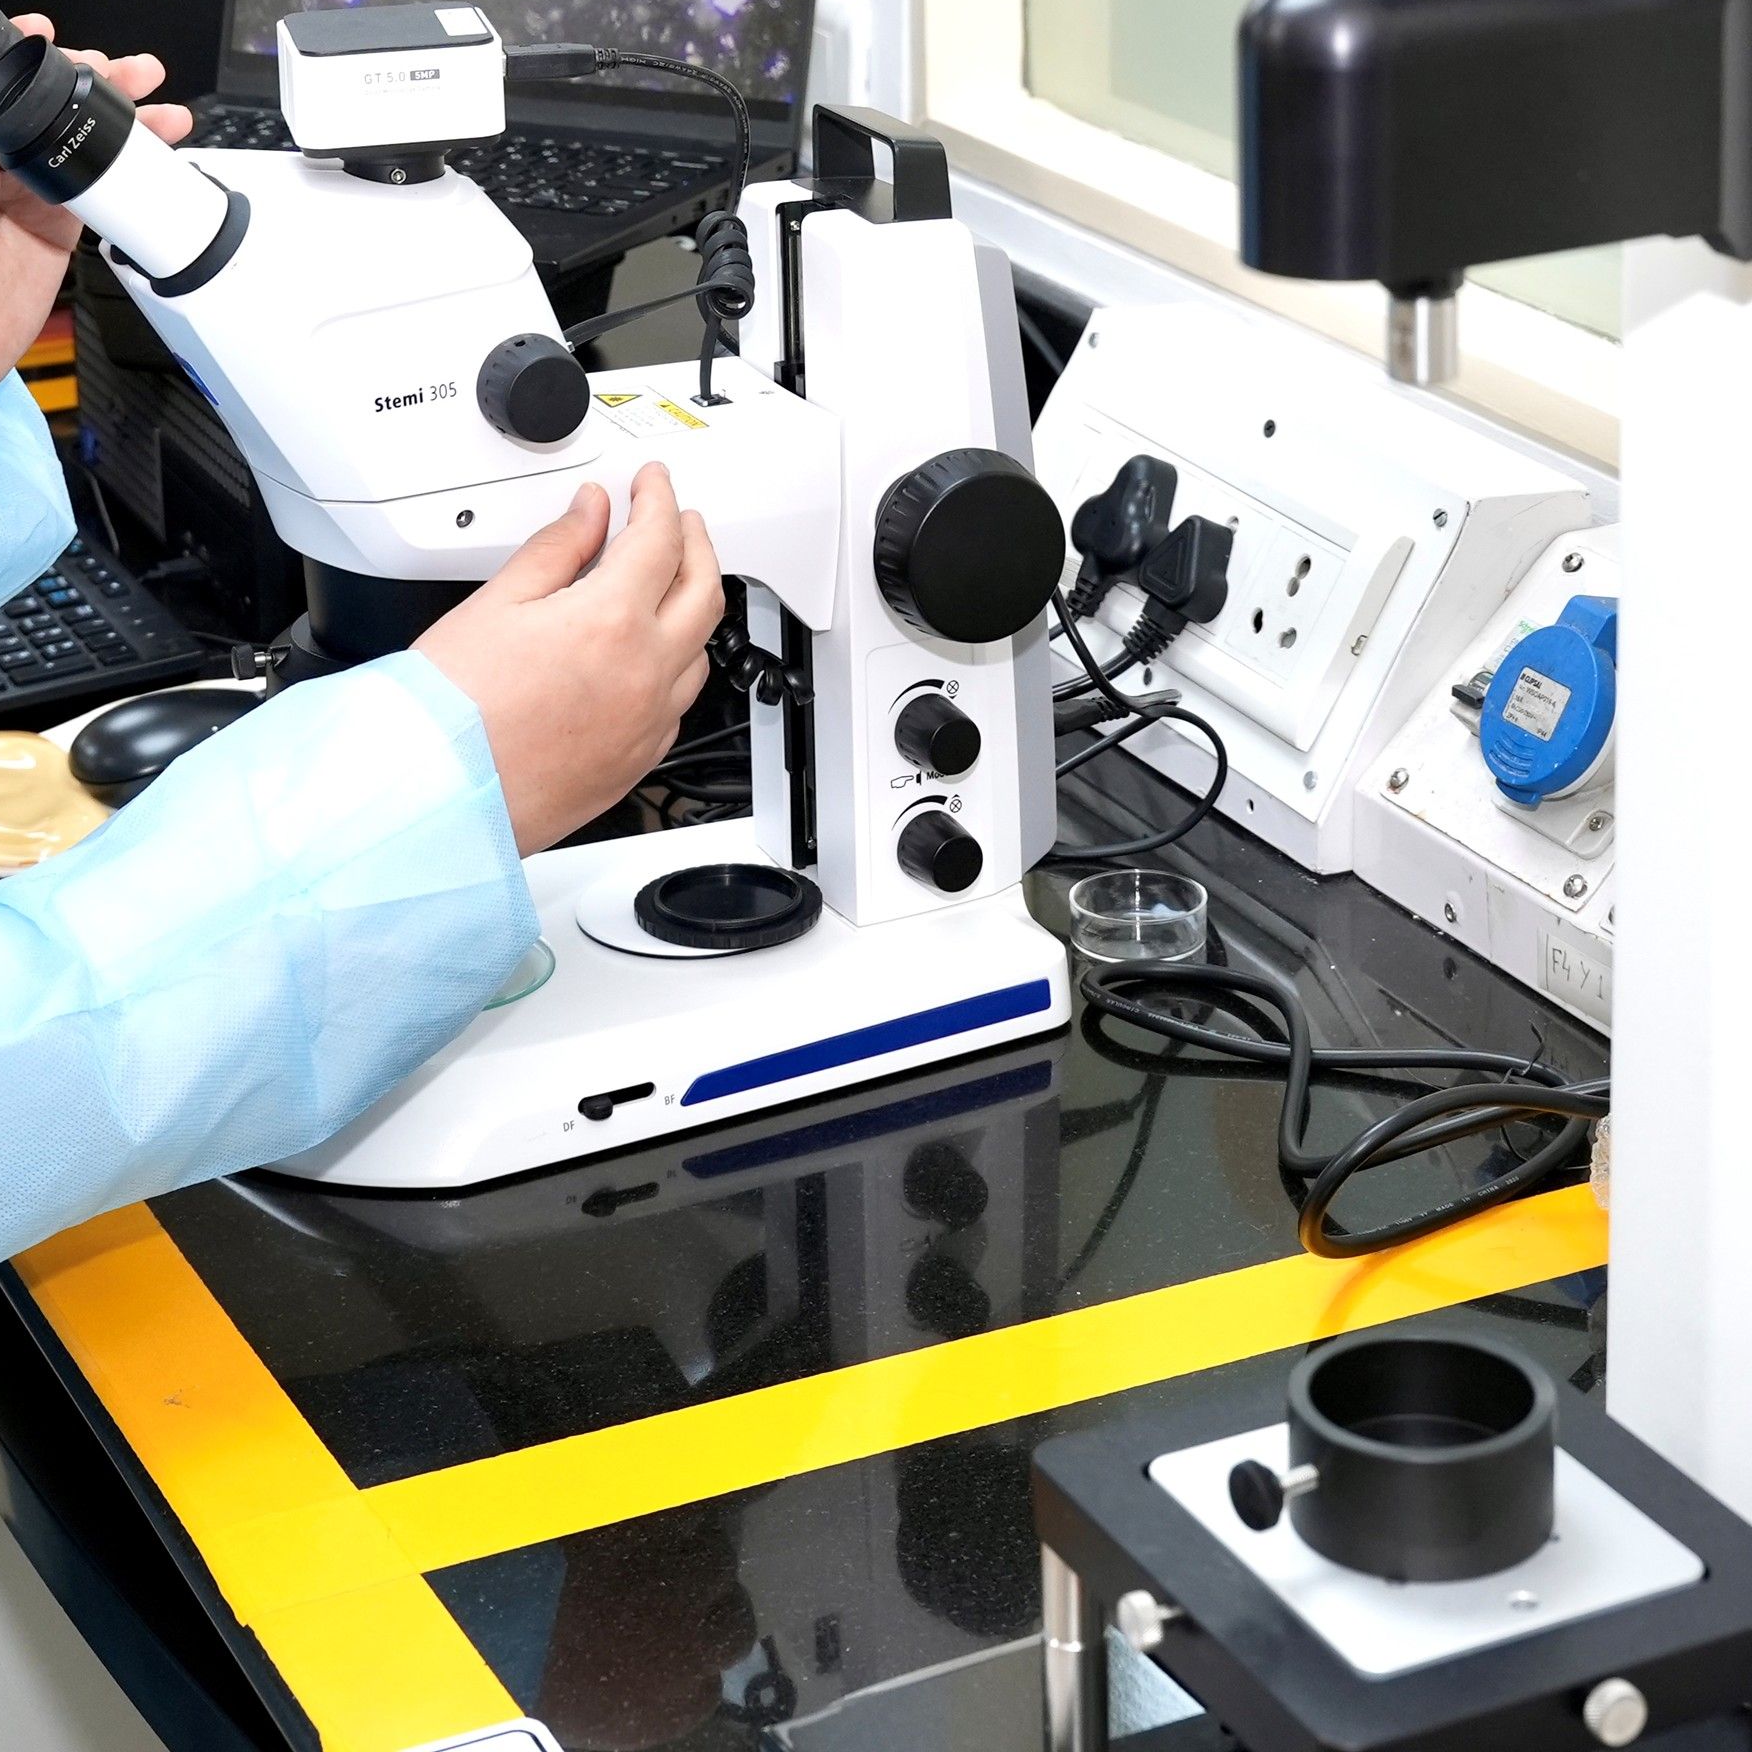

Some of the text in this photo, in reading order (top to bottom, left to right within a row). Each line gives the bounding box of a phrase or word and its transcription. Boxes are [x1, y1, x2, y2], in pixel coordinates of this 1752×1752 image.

[415, 70, 436, 80] 5MP
[48, 117, 96, 168] Carl Zeiss
[374, 381, 457, 413] Stemi 305
[664, 1094, 675, 1106] BF
[563, 1120, 575, 1132] DF
[1477, 1185, 1499, 1197] CHINA
